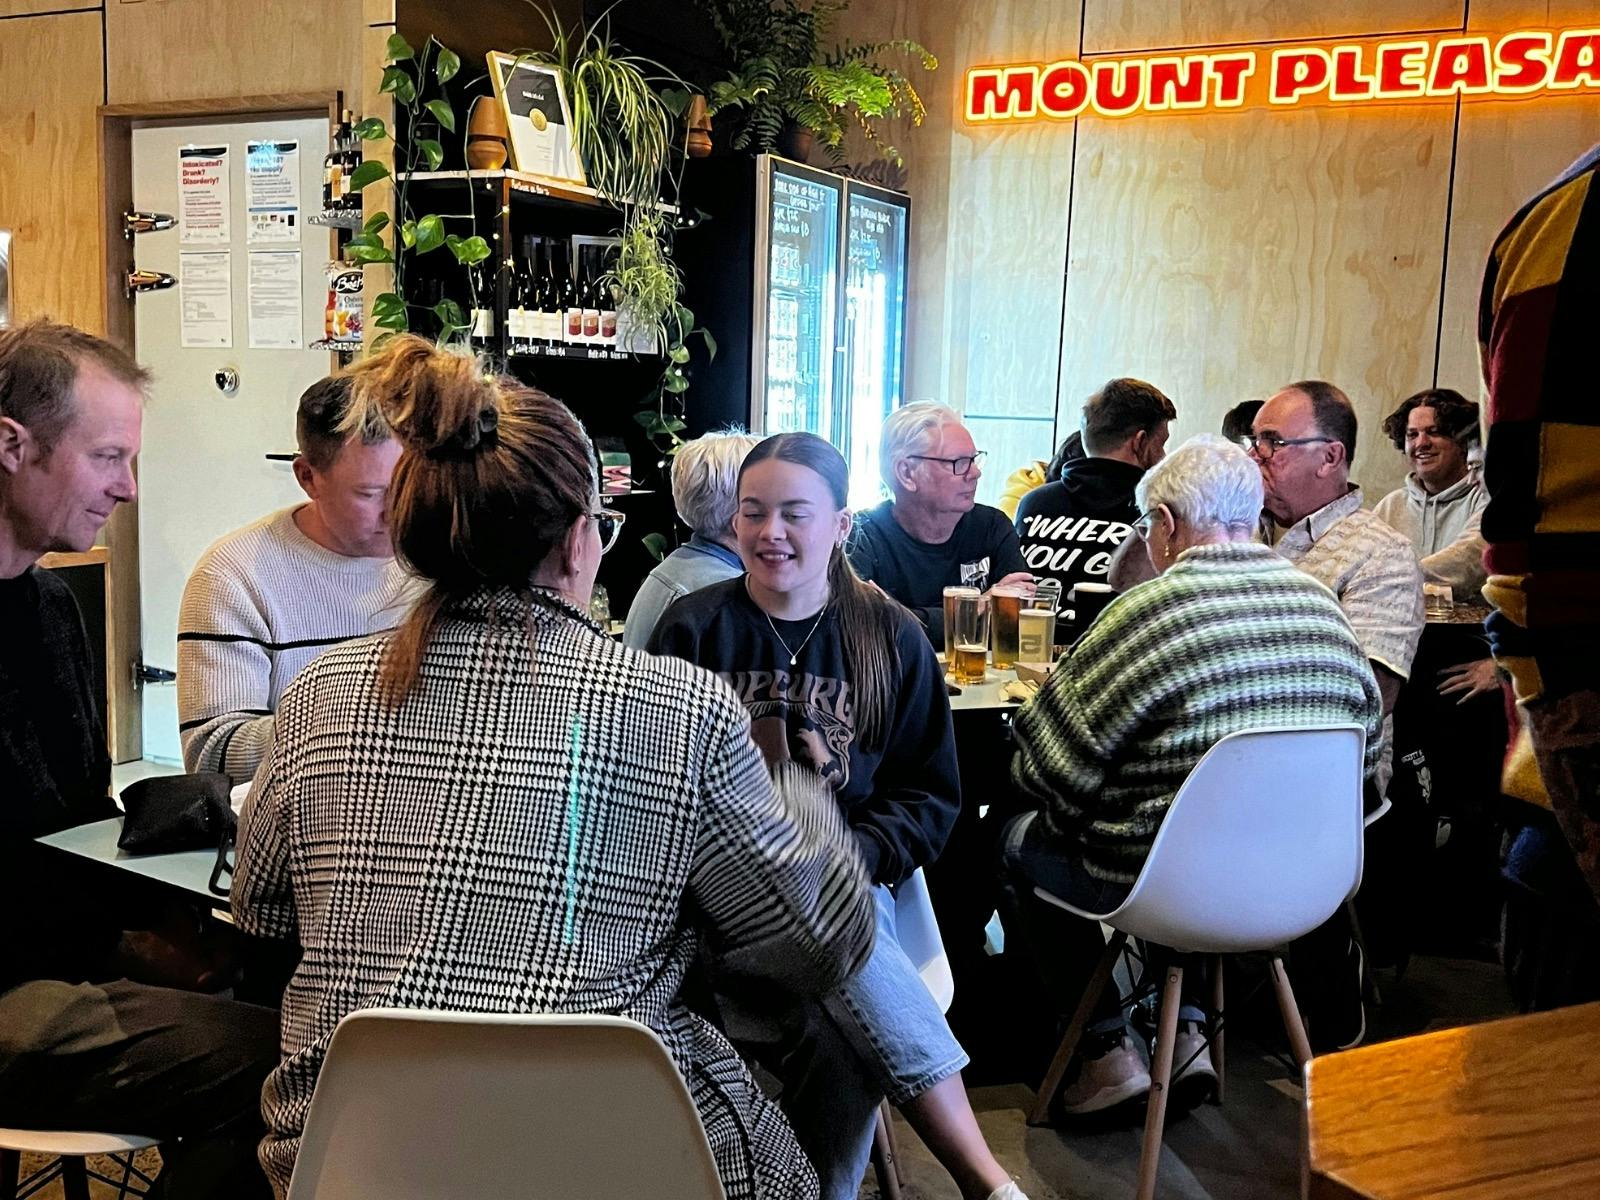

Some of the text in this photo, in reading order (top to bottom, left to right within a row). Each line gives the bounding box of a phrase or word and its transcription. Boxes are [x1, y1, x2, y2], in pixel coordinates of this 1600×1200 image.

[966, 52, 1256, 120] MOUNT
[182, 159, 223, 168] Intoxicated?
[182, 177, 220, 185] Disorderly?
[1020, 543, 1082, 572] YOU
